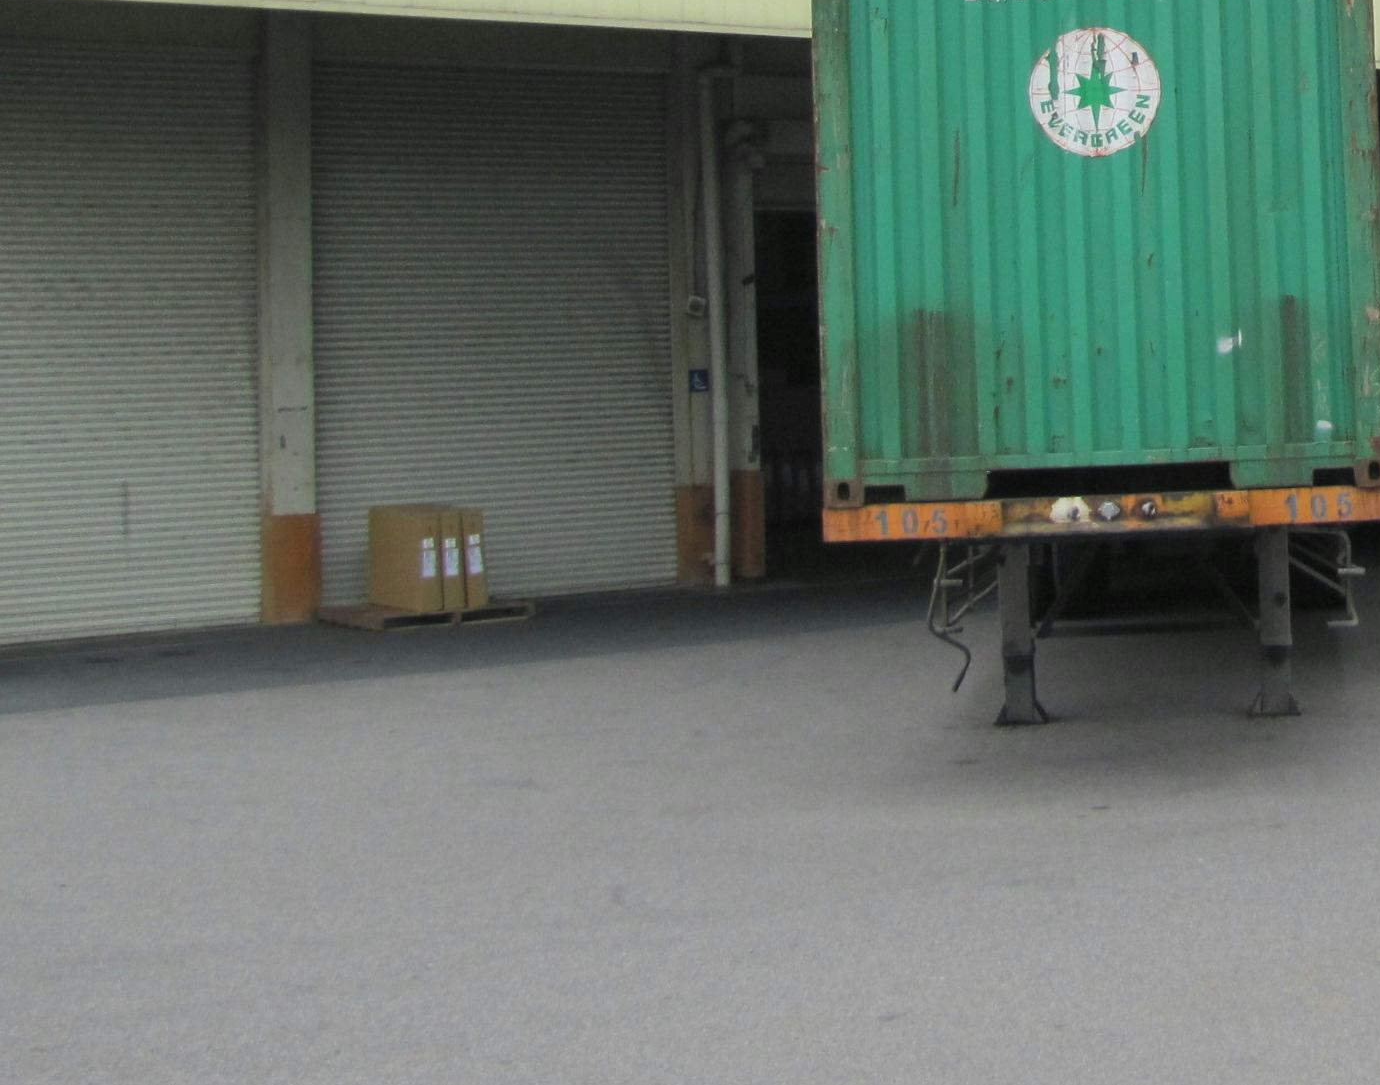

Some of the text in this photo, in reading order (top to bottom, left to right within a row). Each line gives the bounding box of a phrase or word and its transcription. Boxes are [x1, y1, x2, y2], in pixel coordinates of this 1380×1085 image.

[1040, 94, 1151, 148] EVERGREEN
[874, 509, 948, 535] 105
[1285, 491, 1353, 522] 105
